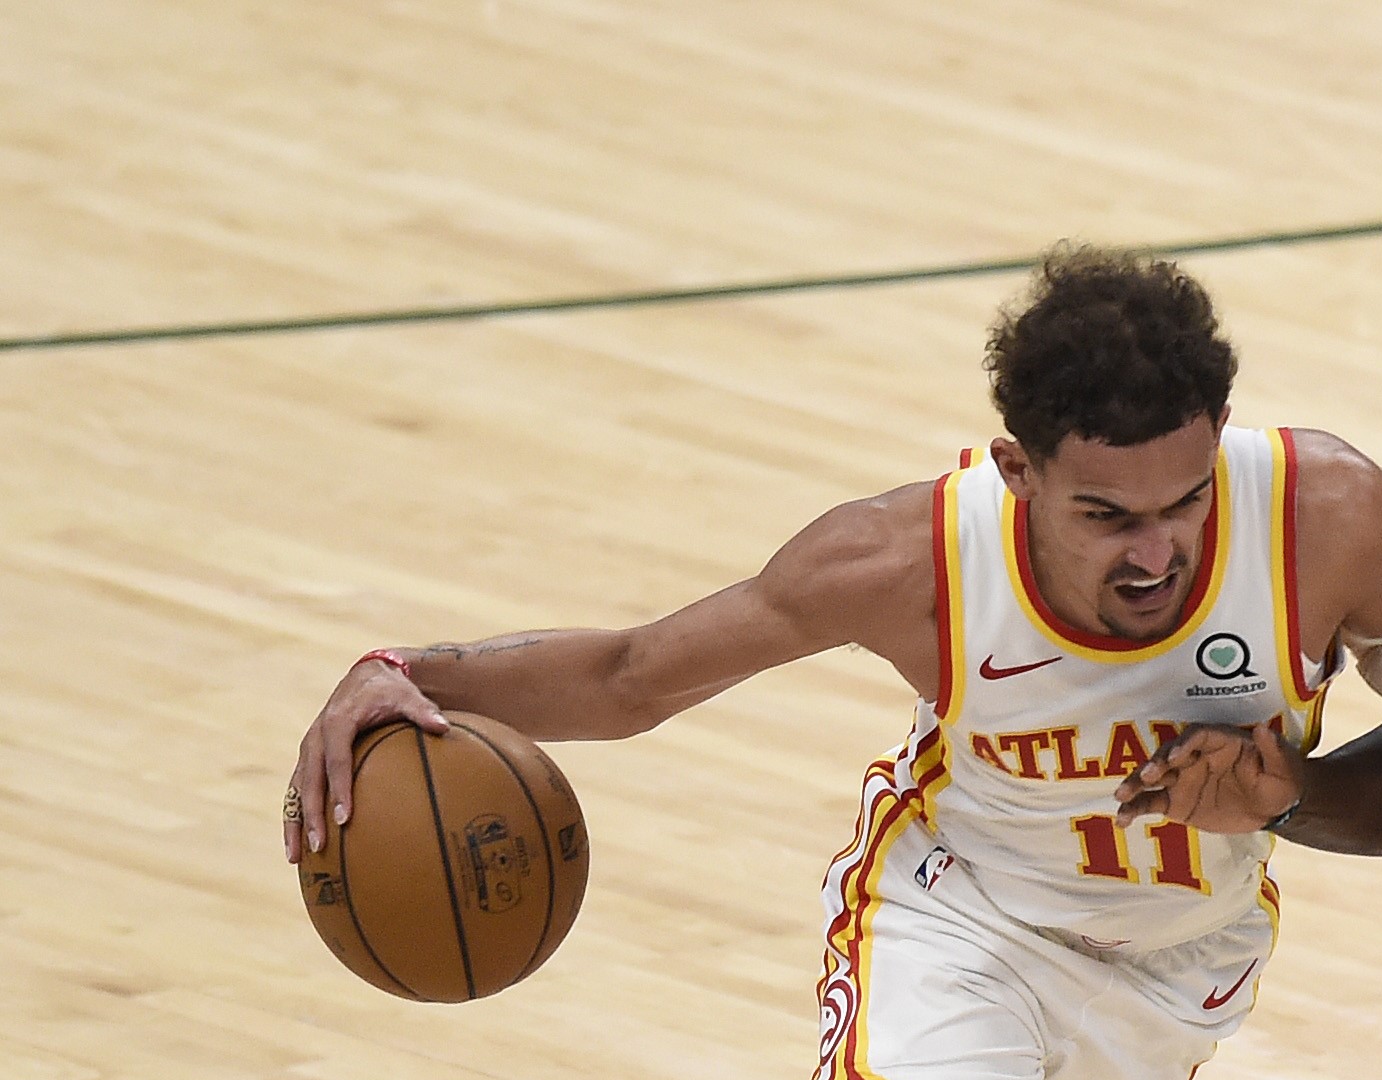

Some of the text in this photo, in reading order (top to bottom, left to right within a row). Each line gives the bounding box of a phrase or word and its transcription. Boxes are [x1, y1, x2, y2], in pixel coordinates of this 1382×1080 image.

[1185, 681, 1267, 697] sharecare
[969, 711, 1285, 781] ATLA
[1070, 813, 1212, 896] 11
